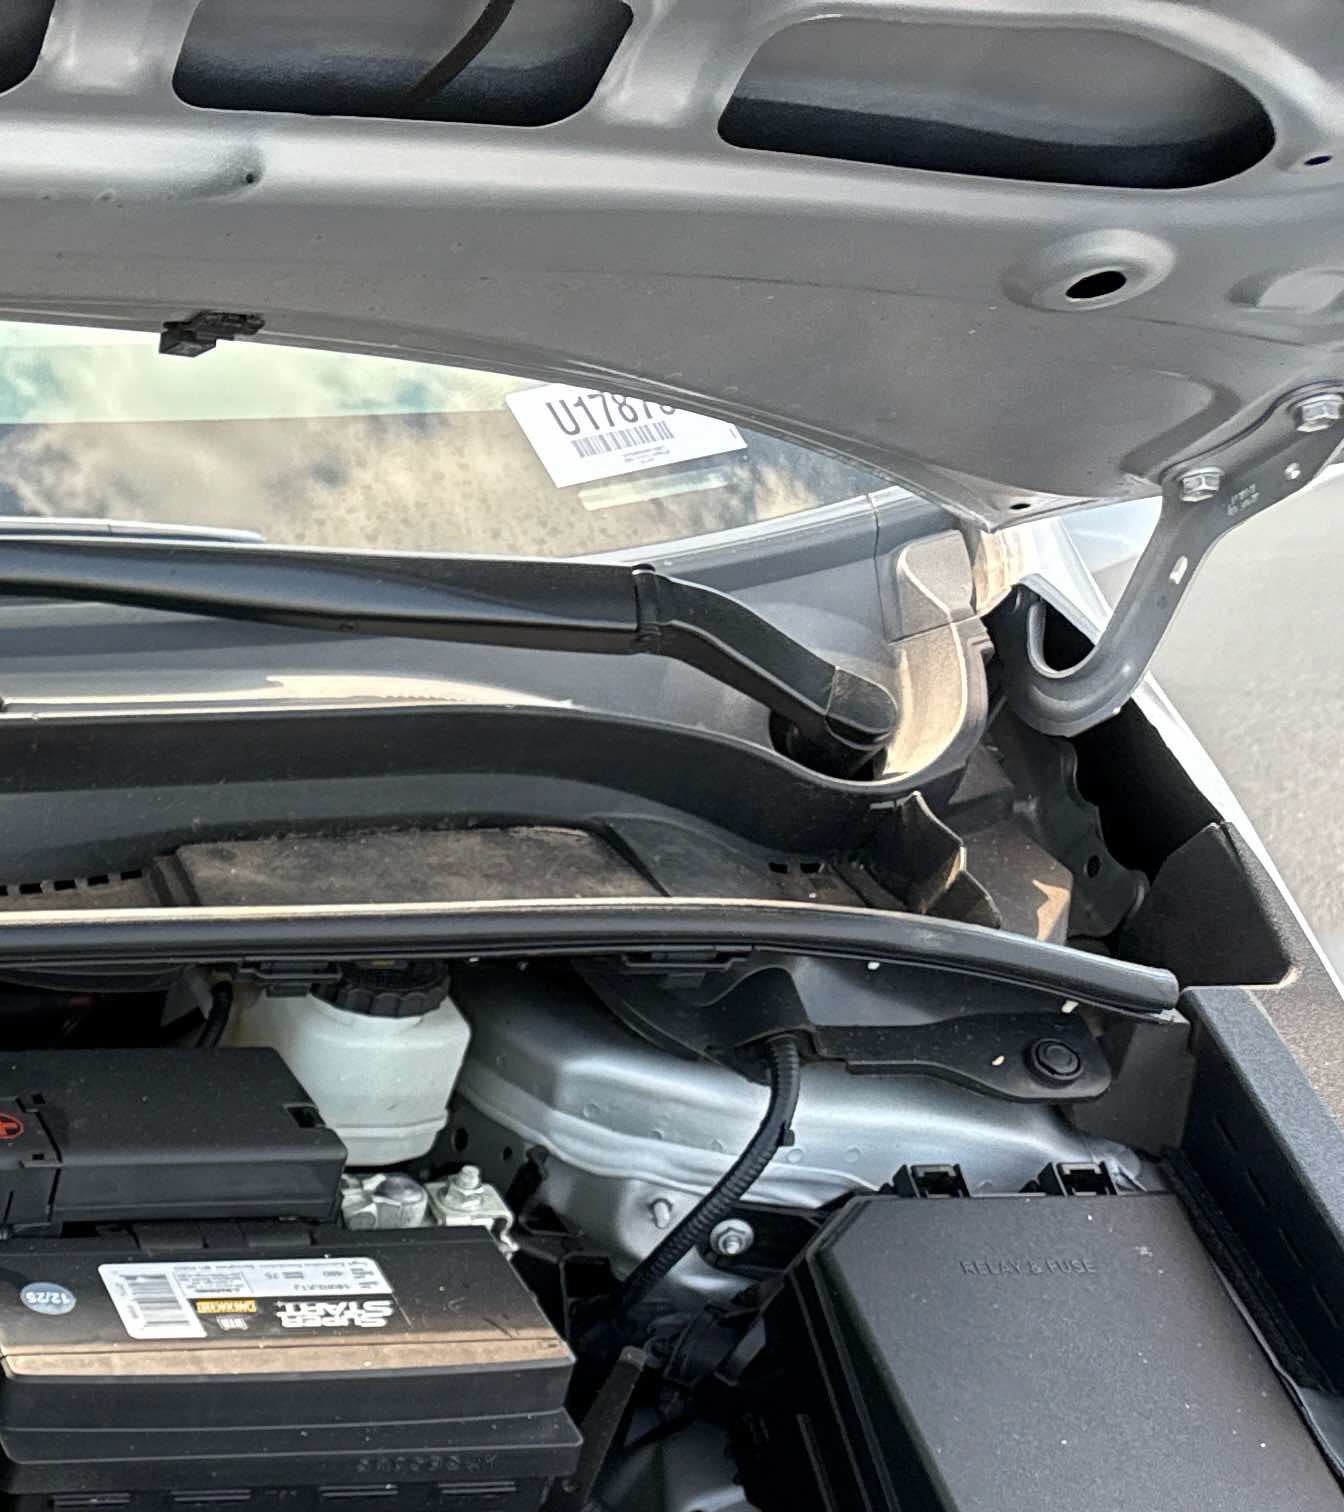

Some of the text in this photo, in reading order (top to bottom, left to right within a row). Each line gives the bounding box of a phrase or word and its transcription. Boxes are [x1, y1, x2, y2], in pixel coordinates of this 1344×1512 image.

[545, 391, 676, 436] U1787
[959, 1260, 1021, 1275] RELAY
[1045, 1258, 1096, 1274] FUSE
[276, 1300, 393, 1318] START
[281, 1315, 387, 1328] SUPER
